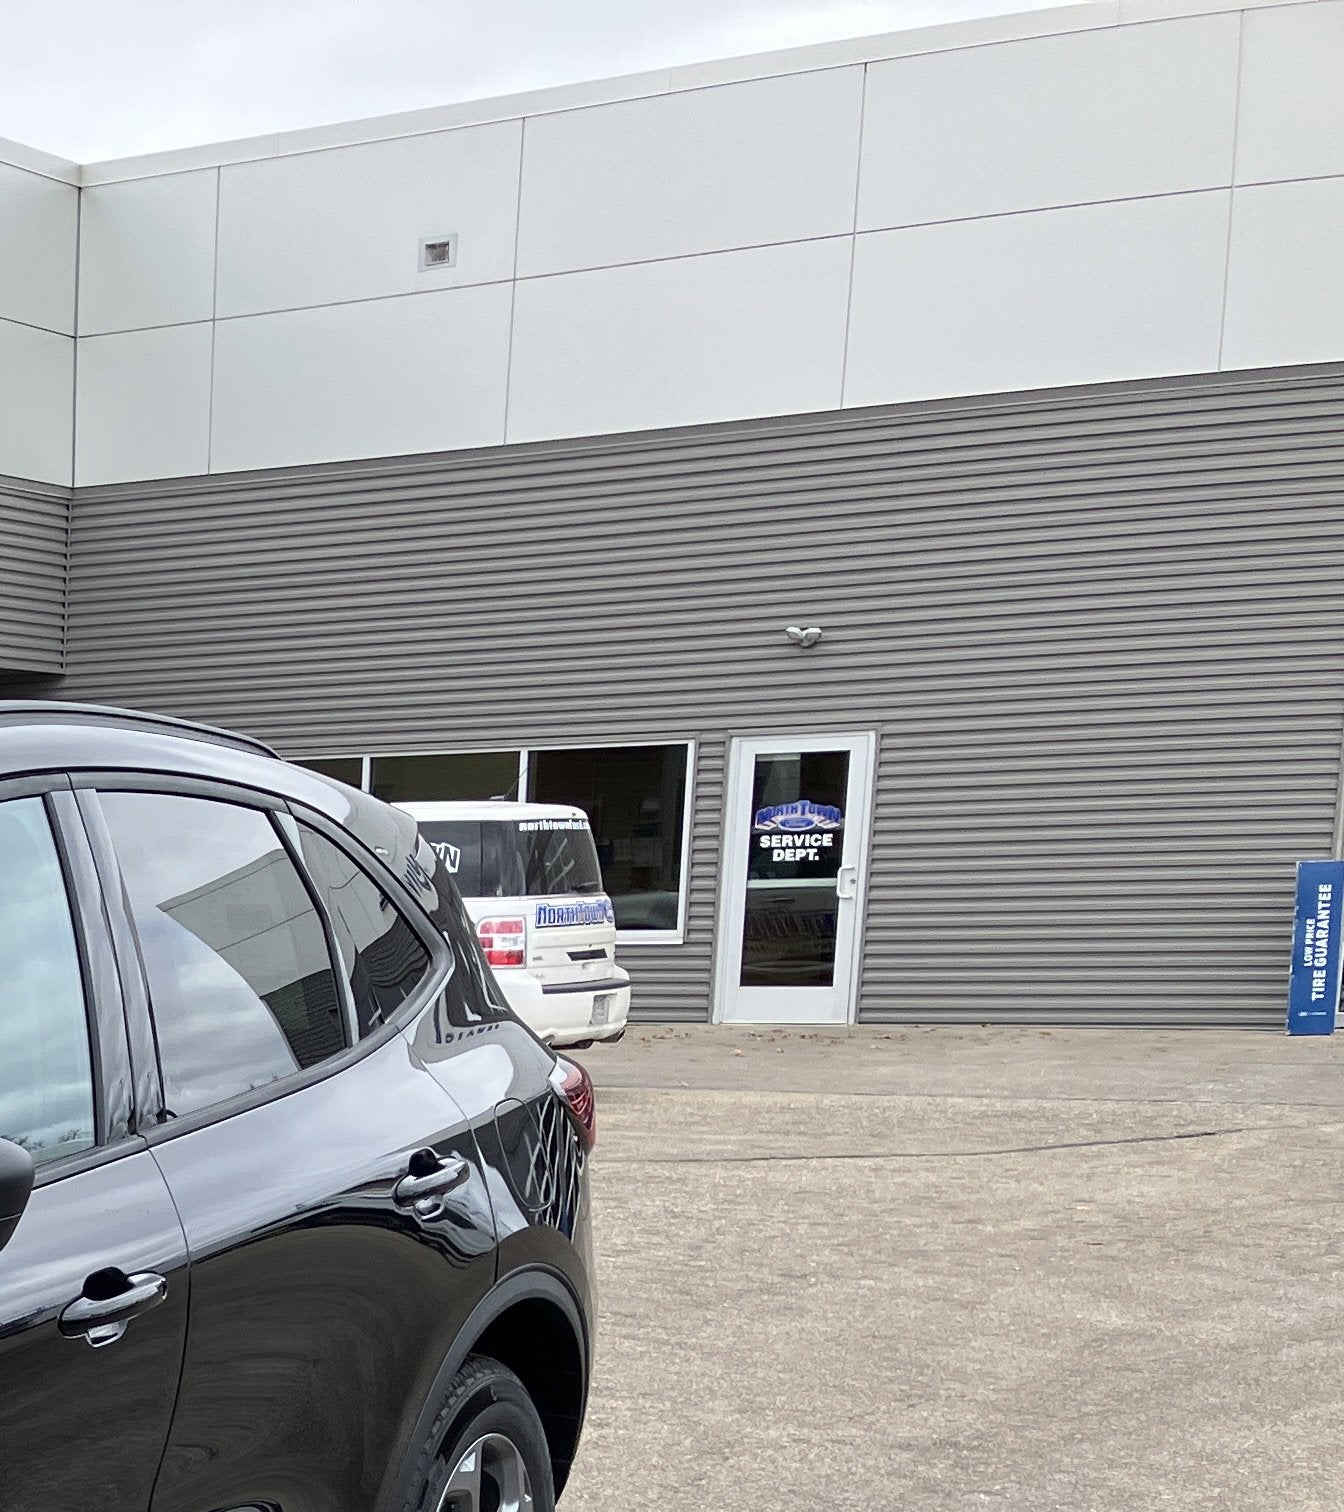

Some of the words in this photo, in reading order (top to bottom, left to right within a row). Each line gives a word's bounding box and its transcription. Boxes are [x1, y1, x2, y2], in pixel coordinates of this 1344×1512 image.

[760, 834, 834, 848] SERVICE
[772, 848, 820, 861] DEPT.
[1305, 918, 1315, 944] PRICE
[1314, 883, 1333, 967] GUARANTEE
[1304, 944, 1313, 967] LOW
[1312, 970, 1326, 1002] TIRE
